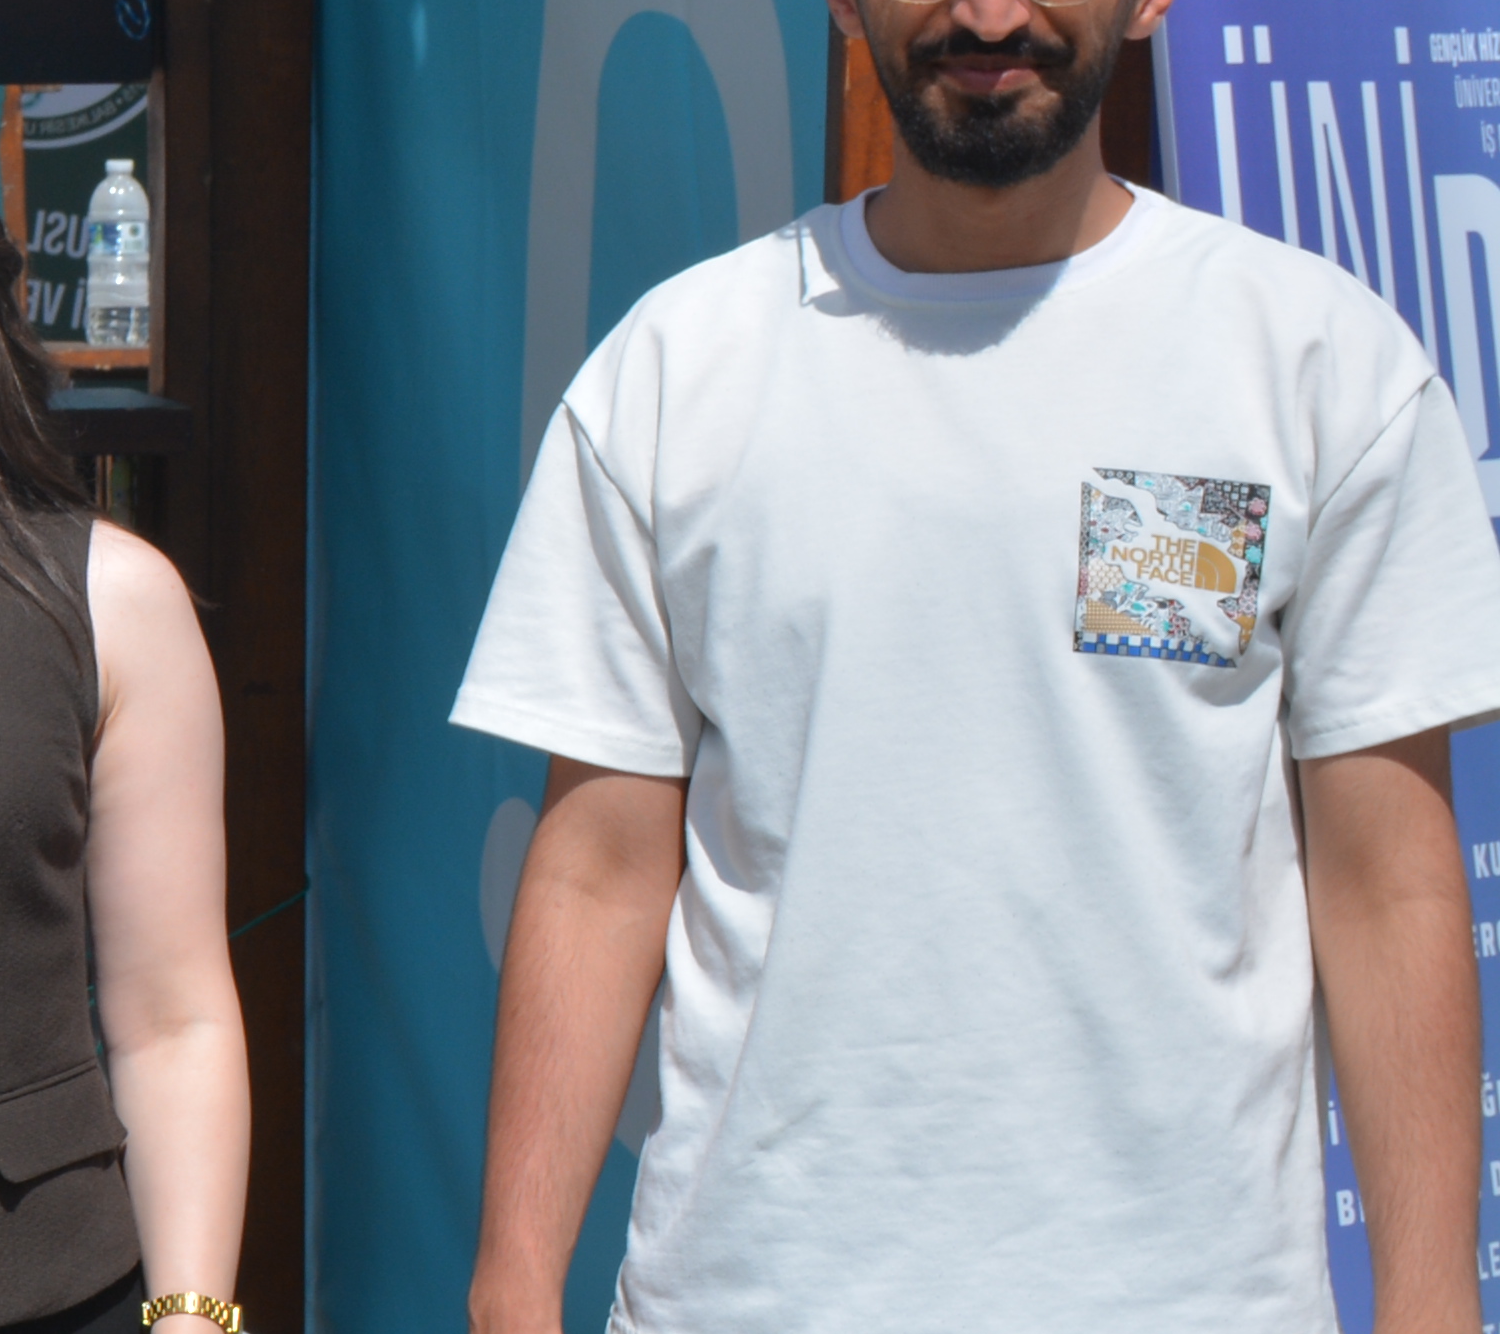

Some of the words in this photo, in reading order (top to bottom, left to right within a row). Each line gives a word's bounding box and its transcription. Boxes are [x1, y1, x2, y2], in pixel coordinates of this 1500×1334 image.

[1111, 545, 1195, 571] NORTH
[1151, 534, 1197, 556] THE
[1136, 562, 1194, 588] FACE
